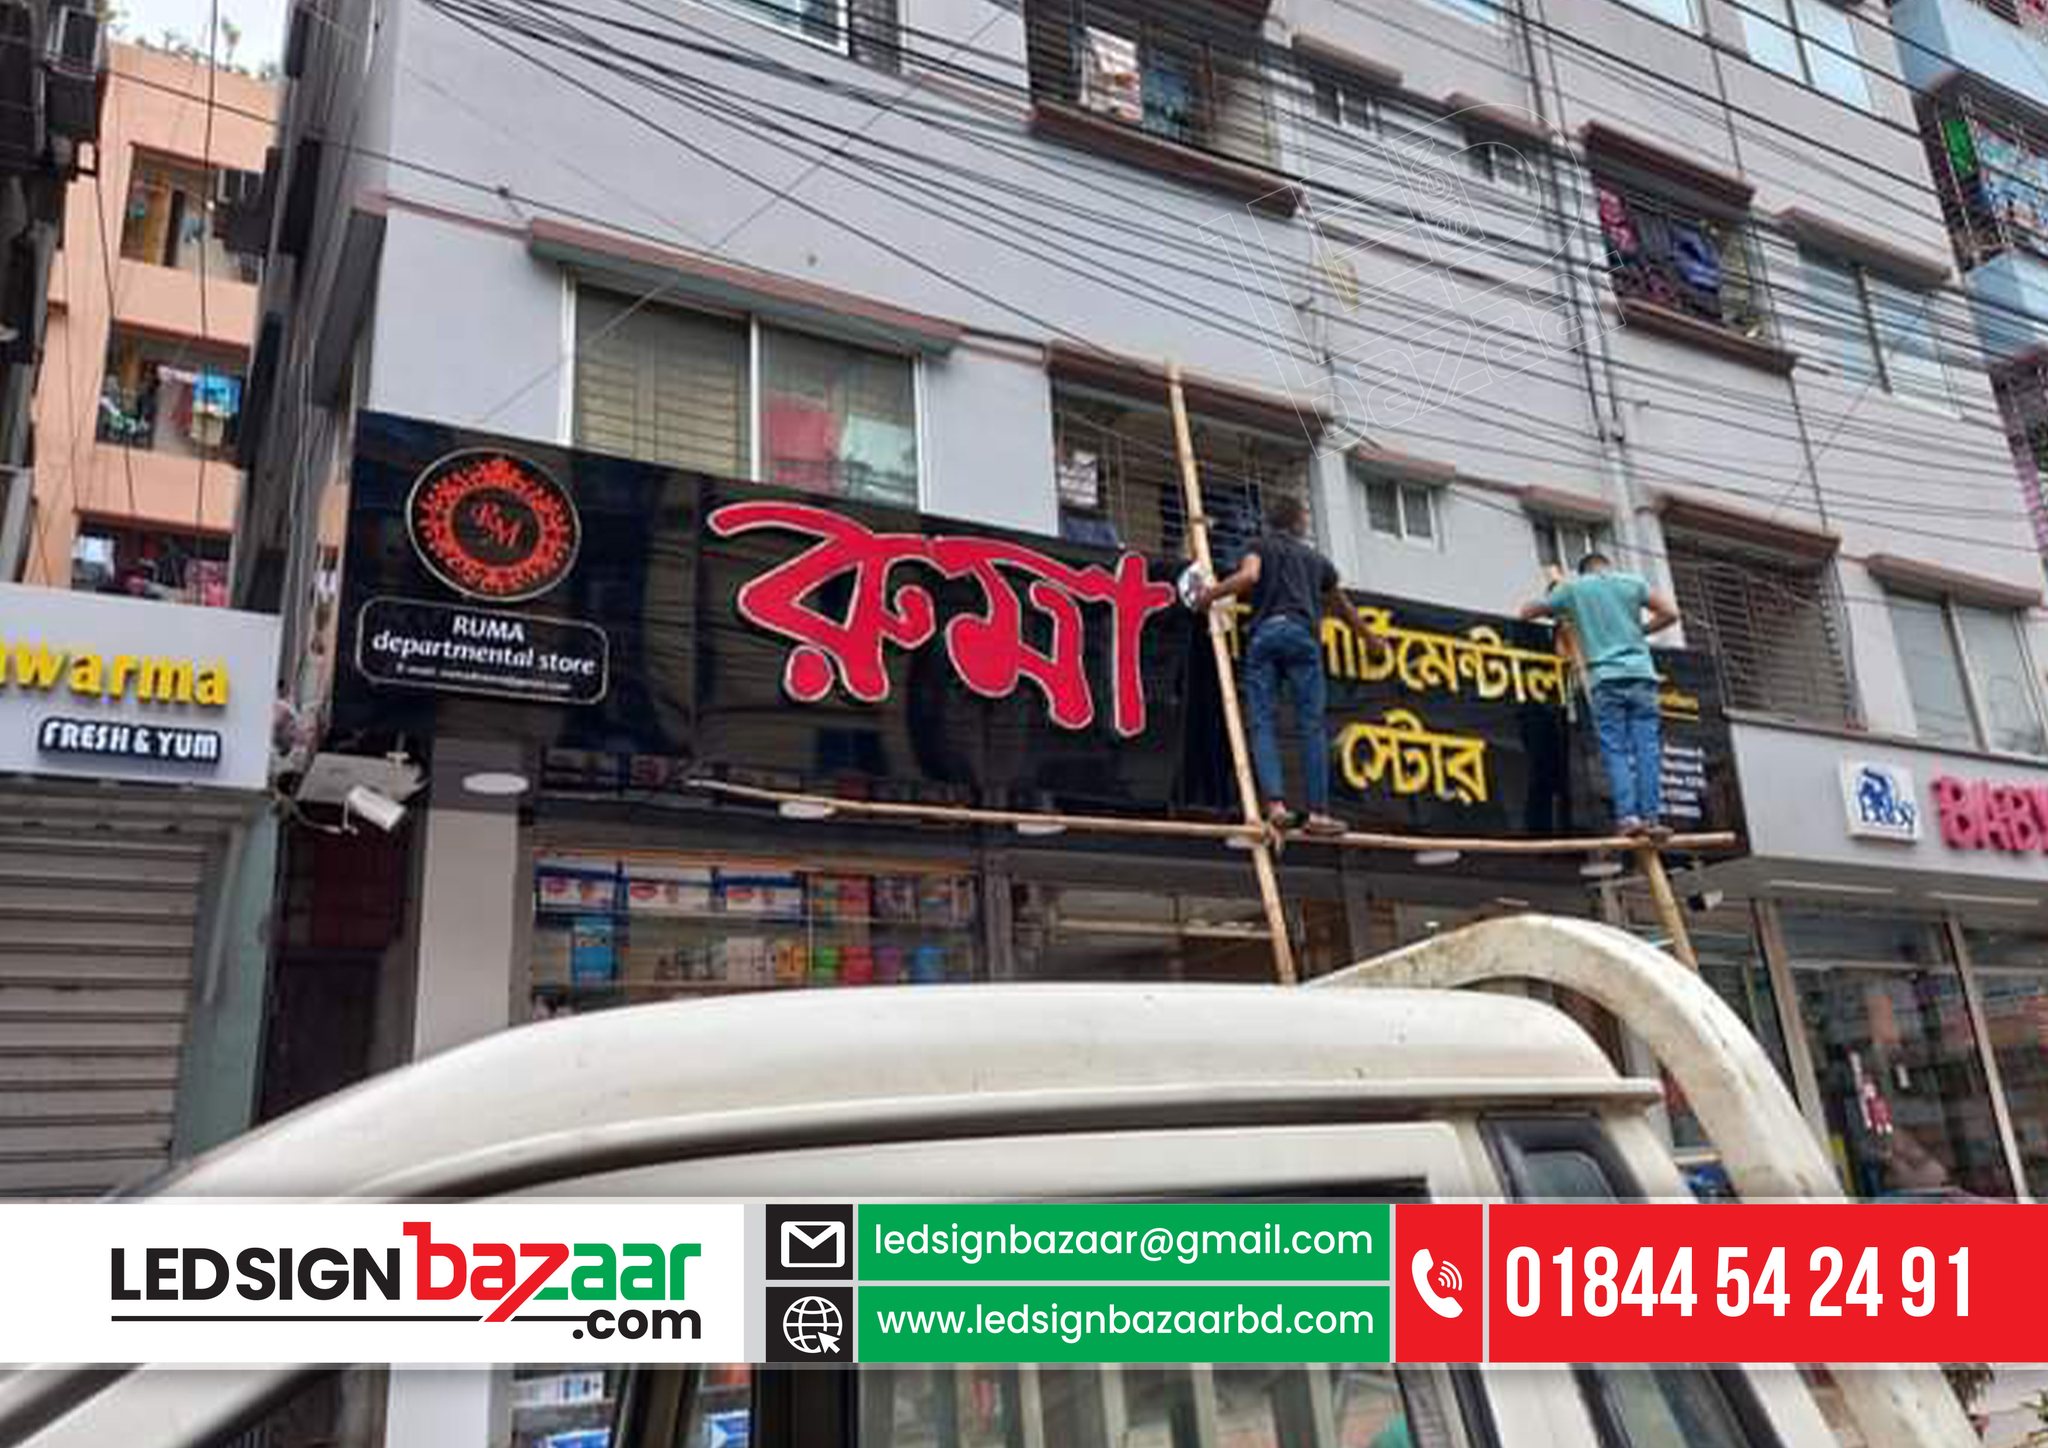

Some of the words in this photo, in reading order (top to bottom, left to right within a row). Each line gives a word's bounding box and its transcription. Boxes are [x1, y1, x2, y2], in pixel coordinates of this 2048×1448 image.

[453, 614, 525, 642] RUMA
[707, 501, 1176, 736] রুমা
[0, 643, 230, 706] warma
[372, 629, 534, 667] departmental
[539, 653, 596, 675] store
[42, 719, 128, 754] FRESH
[156, 730, 219, 760] YUM
[1343, 708, 1487, 806] স্টোর
